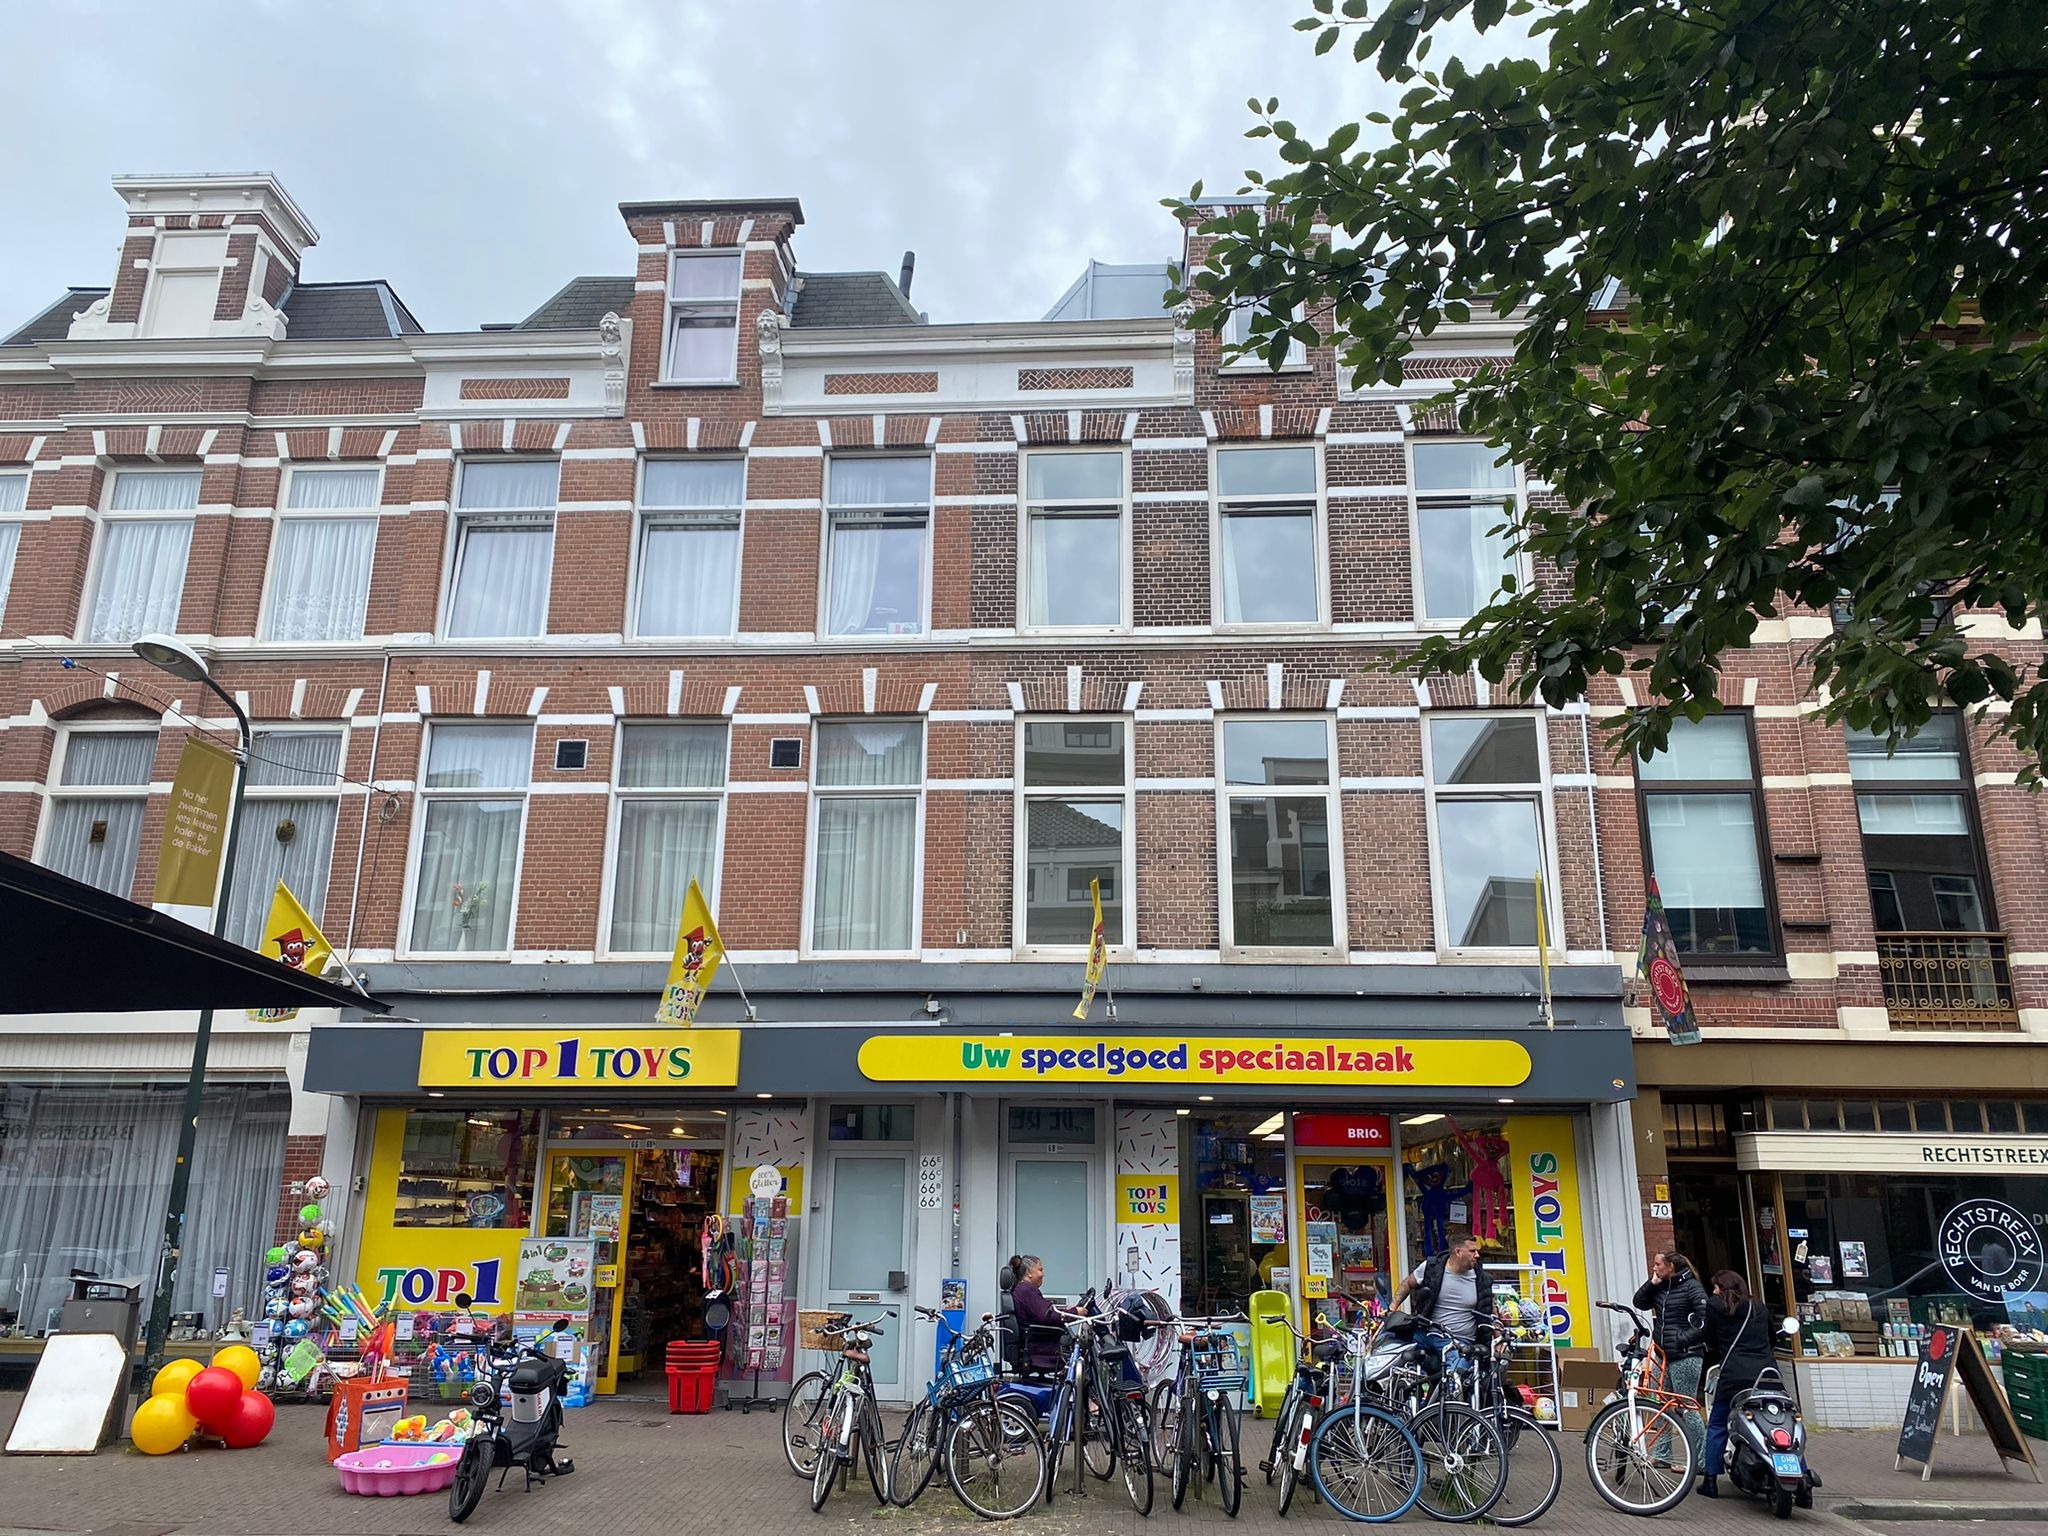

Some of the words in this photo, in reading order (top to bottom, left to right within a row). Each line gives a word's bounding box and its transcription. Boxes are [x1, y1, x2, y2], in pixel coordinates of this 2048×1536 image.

[178, 801, 218, 821] zwemmen
[174, 825, 197, 838] halen
[176, 812, 191, 825] iets
[193, 818, 218, 834] lekkers
[172, 838, 184, 848] de
[587, 1047, 692, 1079] TOYS
[961, 1042, 1011, 1069] Uw
[1021, 1042, 1188, 1076] speelgoed
[1199, 1044, 1416, 1075] speciaalzaak
[631, 1140, 639, 1148] 66
[1922, 1147, 2048, 1163] RECHTSTREEX
[752, 1178, 780, 1189] Glitter
[757, 1170, 775, 1179] 100%
[1530, 1152, 1563, 1244] TOYS
[1129, 1202, 1166, 1214] TOYS
[1653, 1204, 1669, 1216] 70
[1946, 1207, 2037, 1267] RECHTSTREEX
[1970, 1276, 1991, 1292] VAN
[1993, 1284, 2008, 1293] DE
[2008, 1269, 2030, 1290] BOER
[1919, 1361, 1945, 1389] Open
